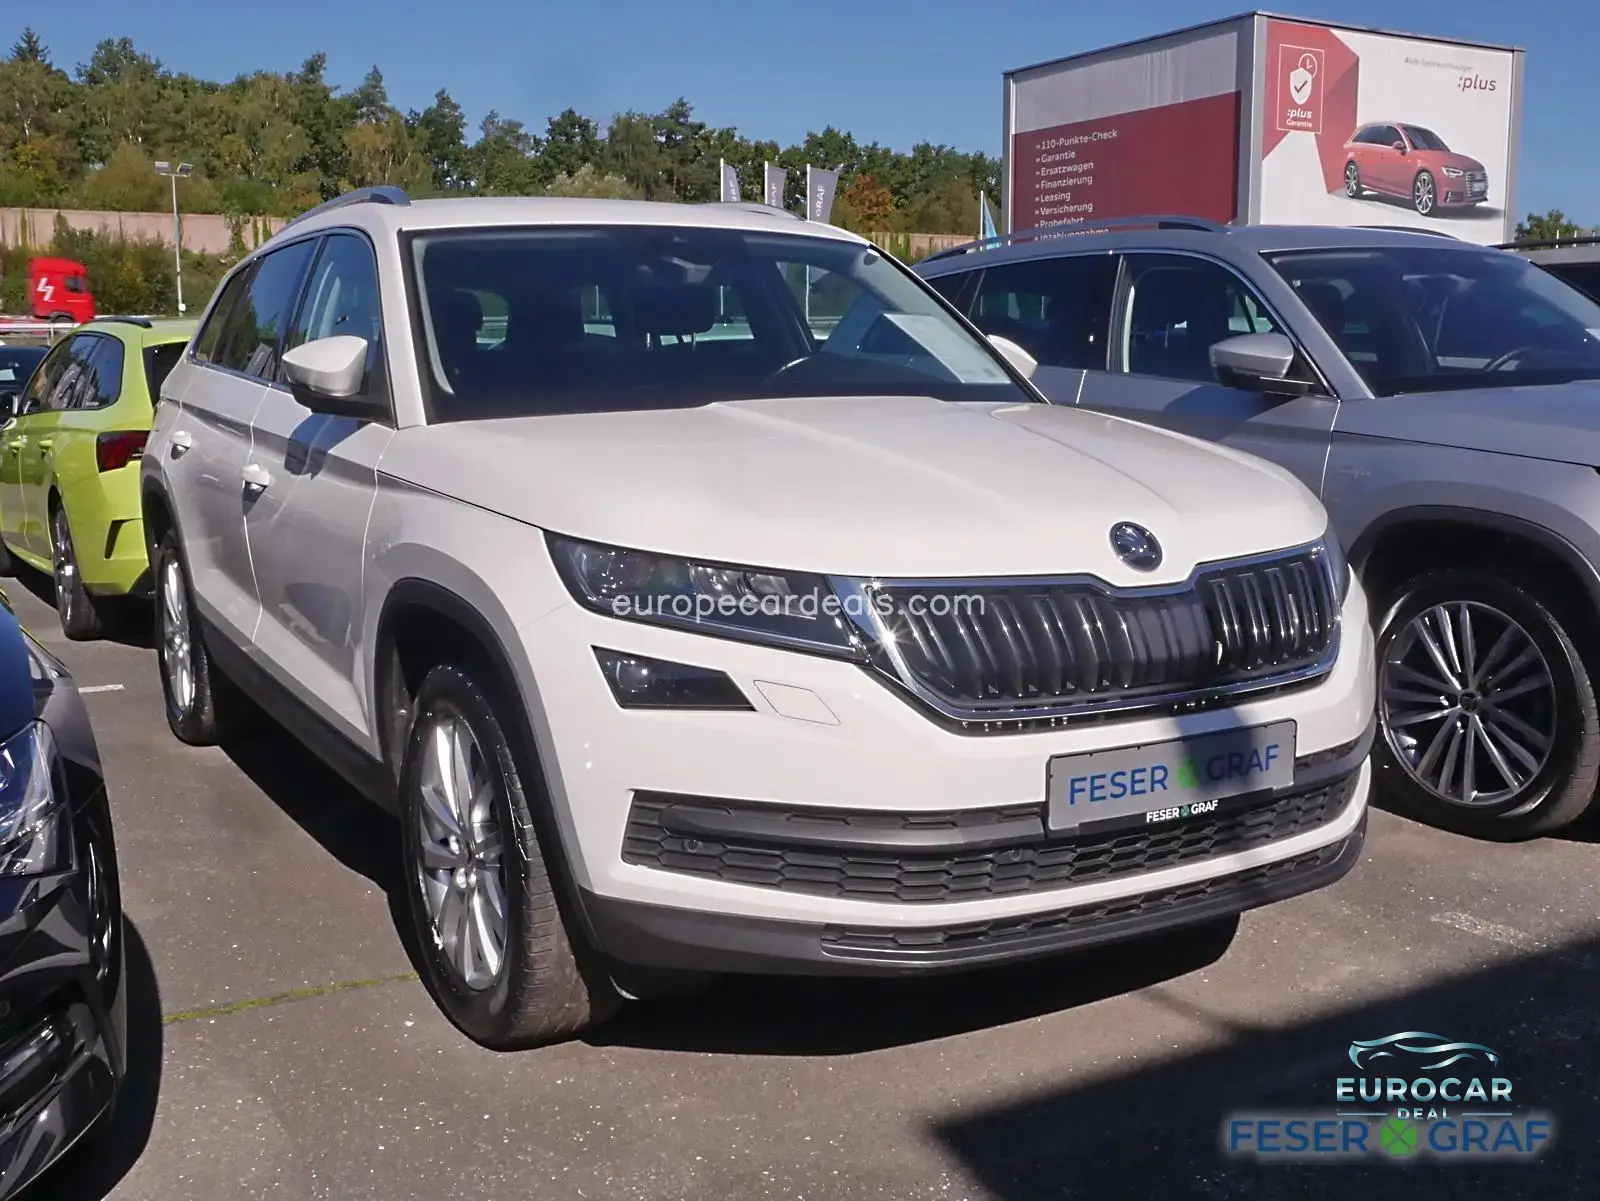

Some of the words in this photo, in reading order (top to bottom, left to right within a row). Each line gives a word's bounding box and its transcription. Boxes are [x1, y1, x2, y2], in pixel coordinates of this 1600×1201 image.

[1286, 119, 1313, 128] Garantie
[1041, 129, 1118, 150] 110-Punkte-Check
[1041, 150, 1076, 163] Garantie
[1041, 162, 1094, 176] Ersatzwagen
[1041, 176, 1093, 189] Finanzierung
[1040, 192, 1071, 203] Leasing
[1040, 203, 1093, 215] Versicherung
[1069, 764, 1169, 806] FESER
[1206, 744, 1280, 782] GRAF
[1146, 807, 1180, 823] FESER
[1190, 799, 1219, 815] GRAF
